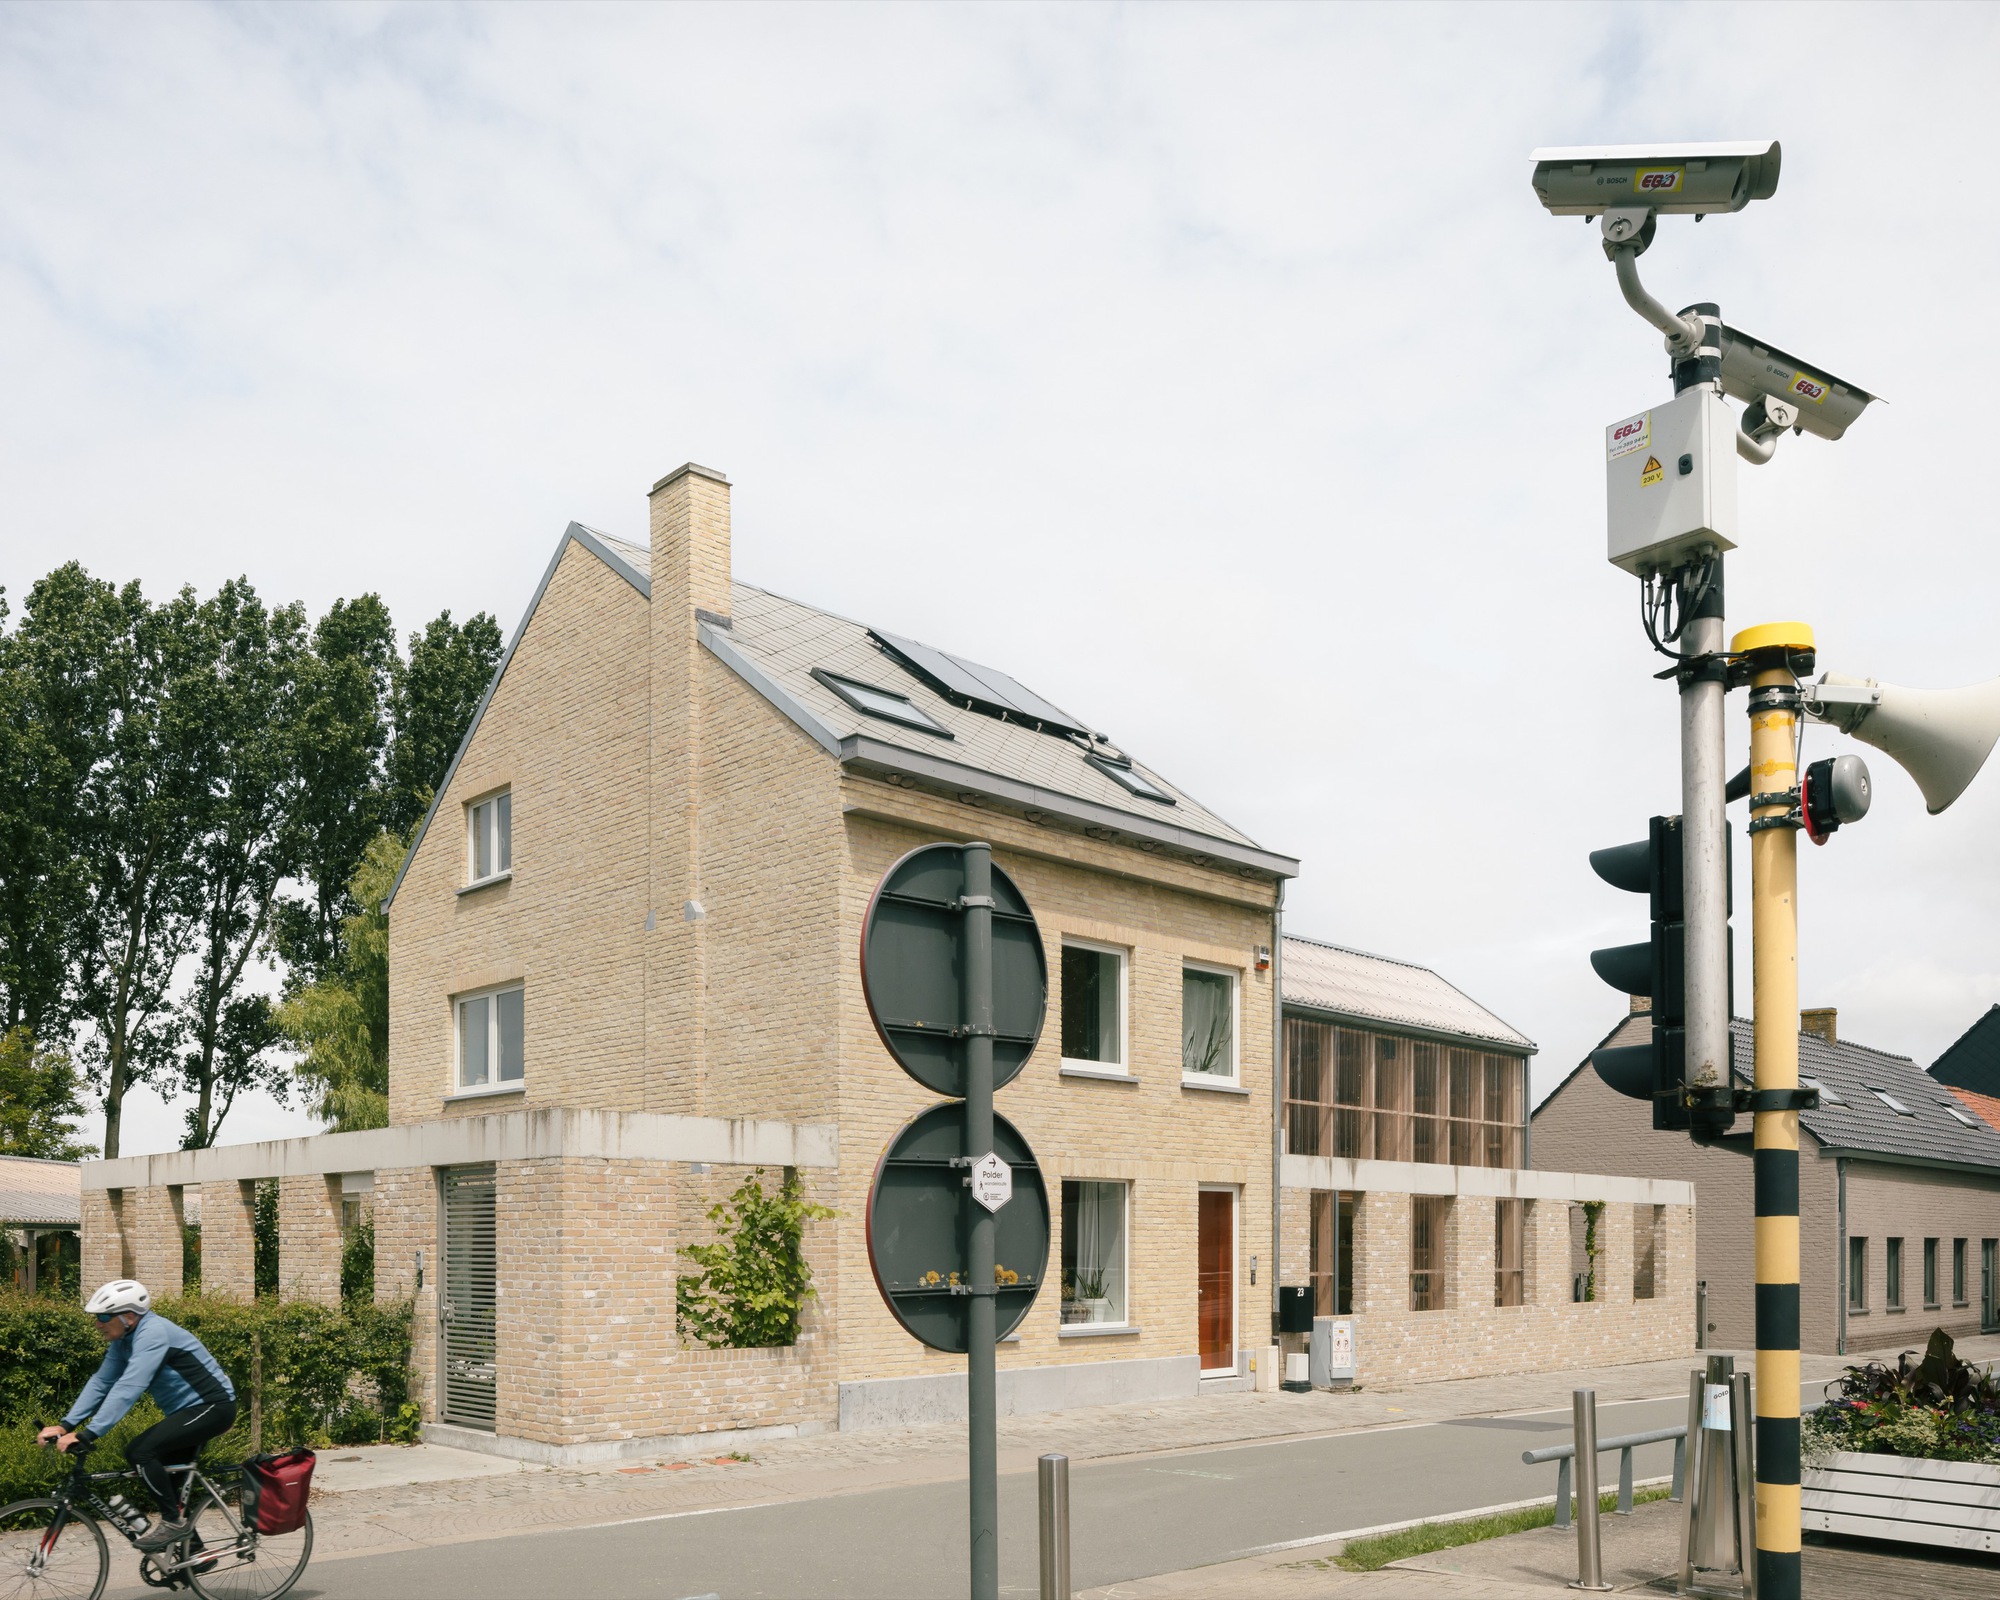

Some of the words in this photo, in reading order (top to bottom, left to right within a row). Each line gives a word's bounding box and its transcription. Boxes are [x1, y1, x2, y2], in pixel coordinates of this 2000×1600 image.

[1773, 368, 1790, 379] BOSCH
[1643, 474, 1655, 484] 230
[982, 1171, 1003, 1179] Polder
[1297, 1287, 1305, 1297] 23
[1713, 1389, 1729, 1400] GOED
